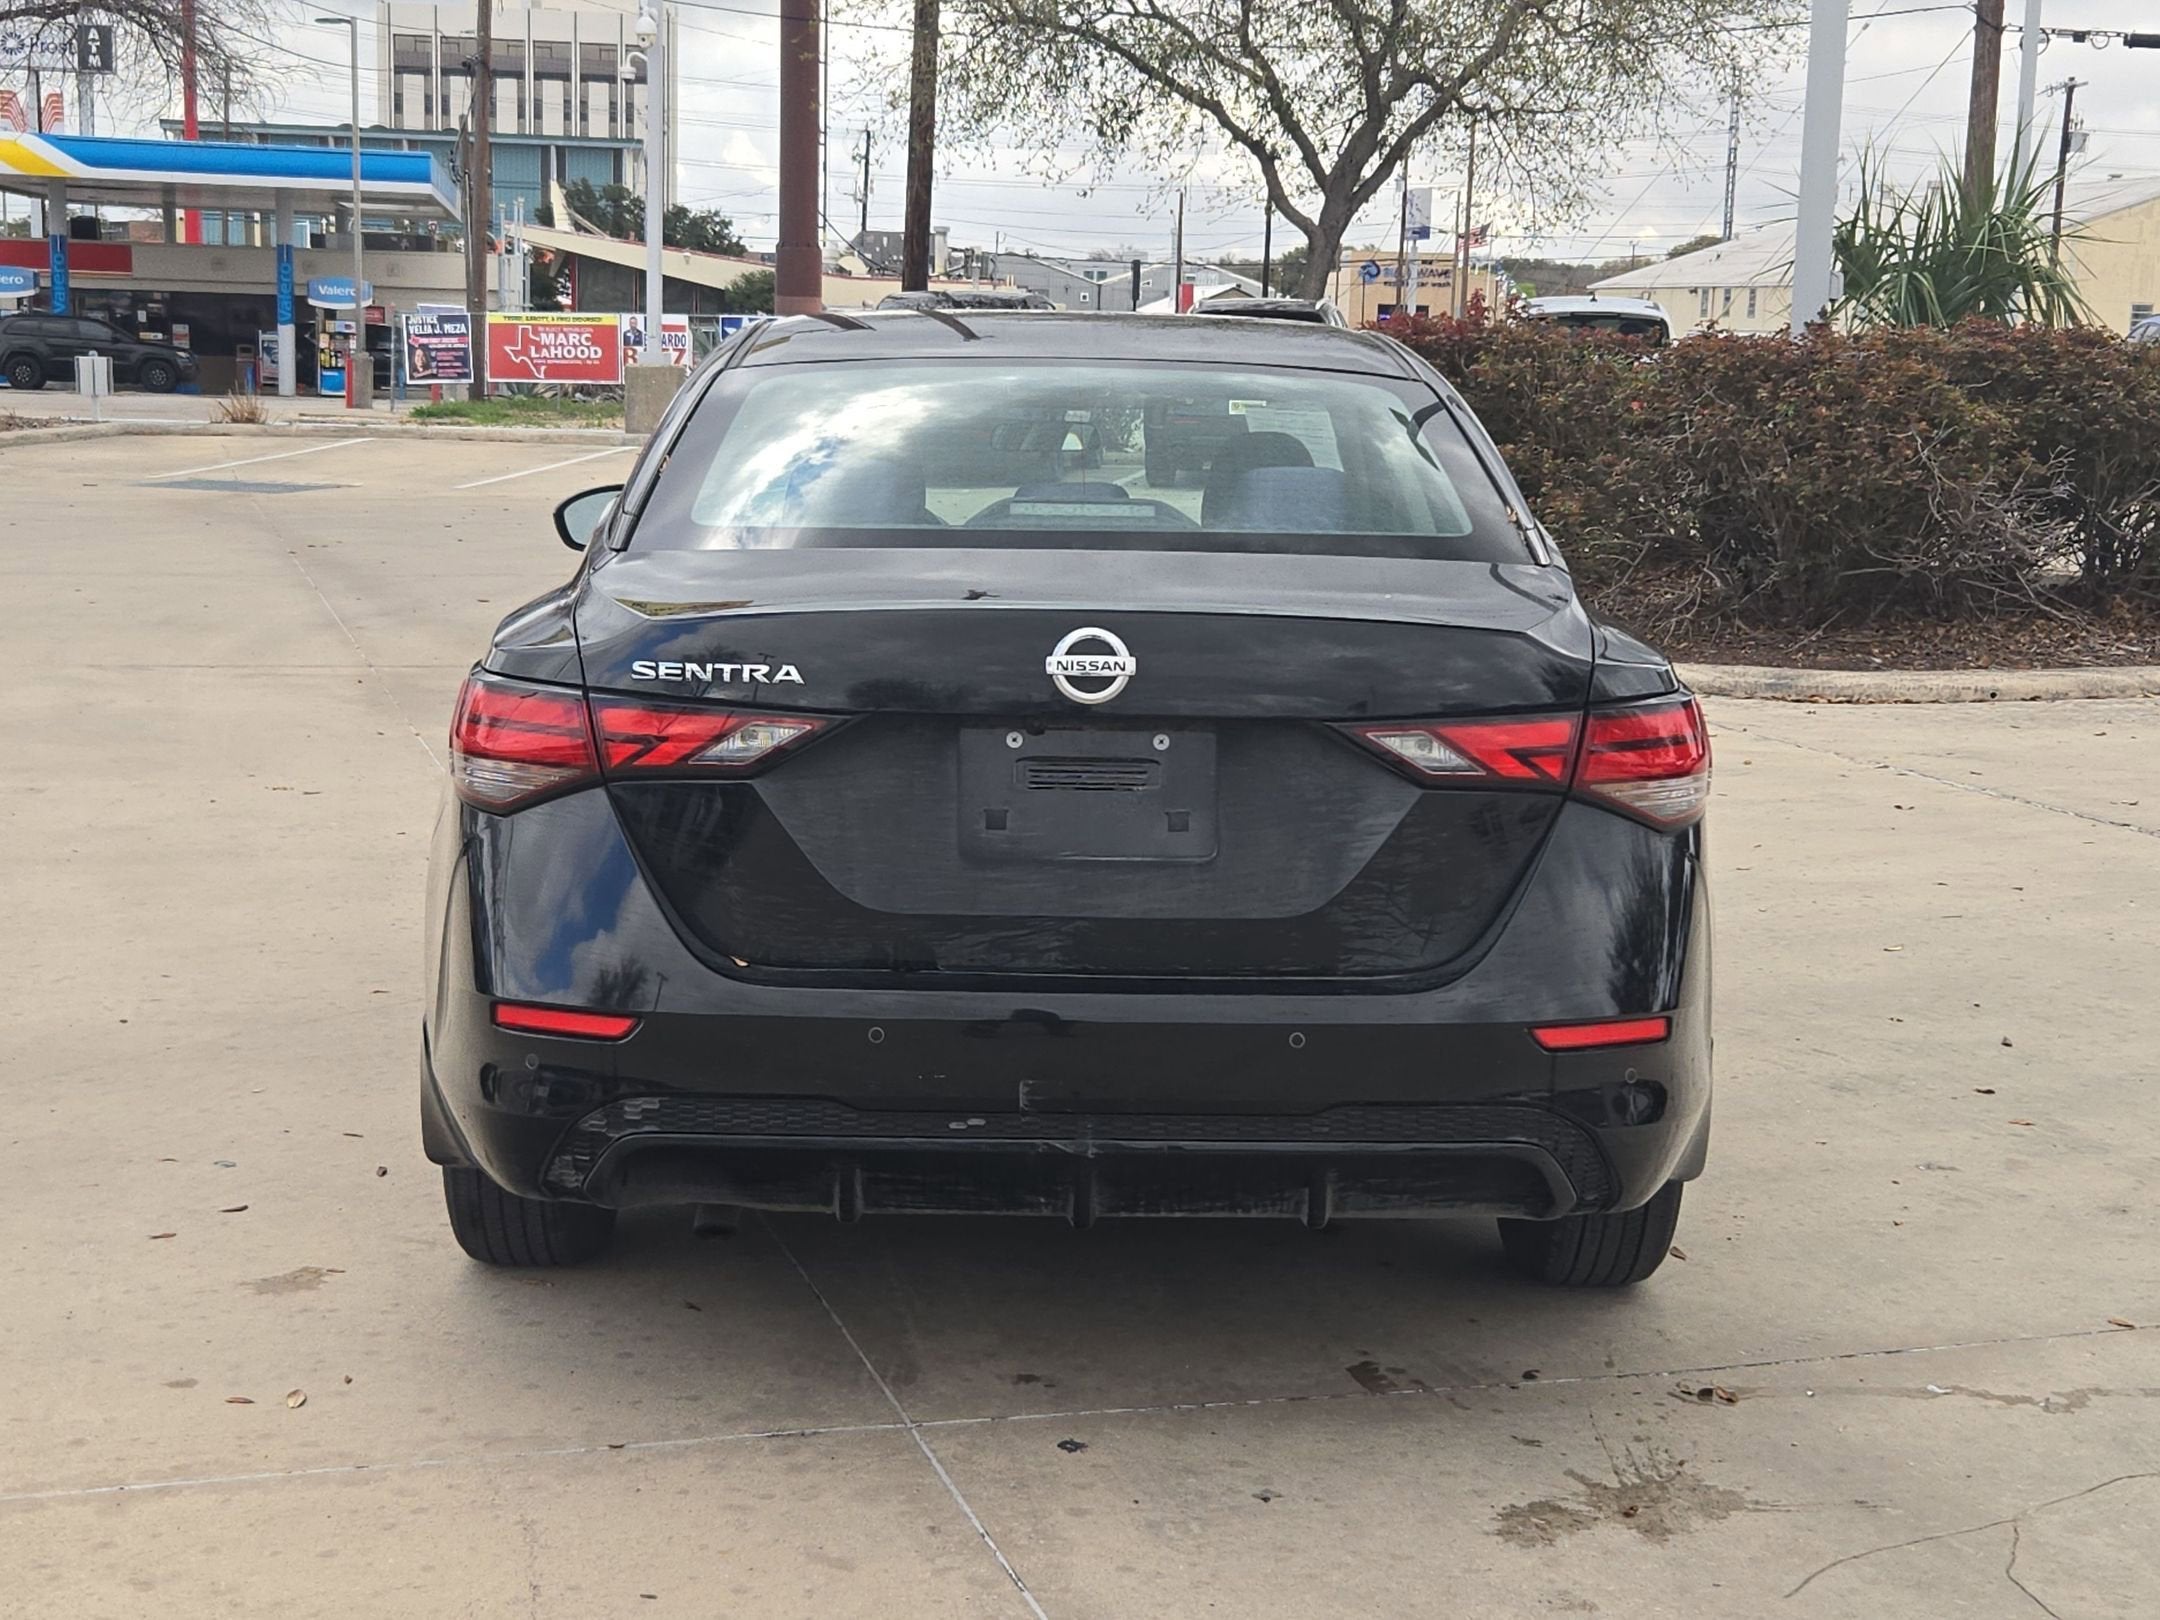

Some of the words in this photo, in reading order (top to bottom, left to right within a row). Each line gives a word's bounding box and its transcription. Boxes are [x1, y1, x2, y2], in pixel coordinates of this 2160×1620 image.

[87, 27, 102, 68] ATM
[0, 274, 24, 285] ero
[53, 253, 66, 314] Valero
[279, 263, 292, 322] Valero
[540, 333, 592, 346] MARC
[631, 661, 805, 685] SENTRA
[1056, 660, 1126, 672] NISSAN
